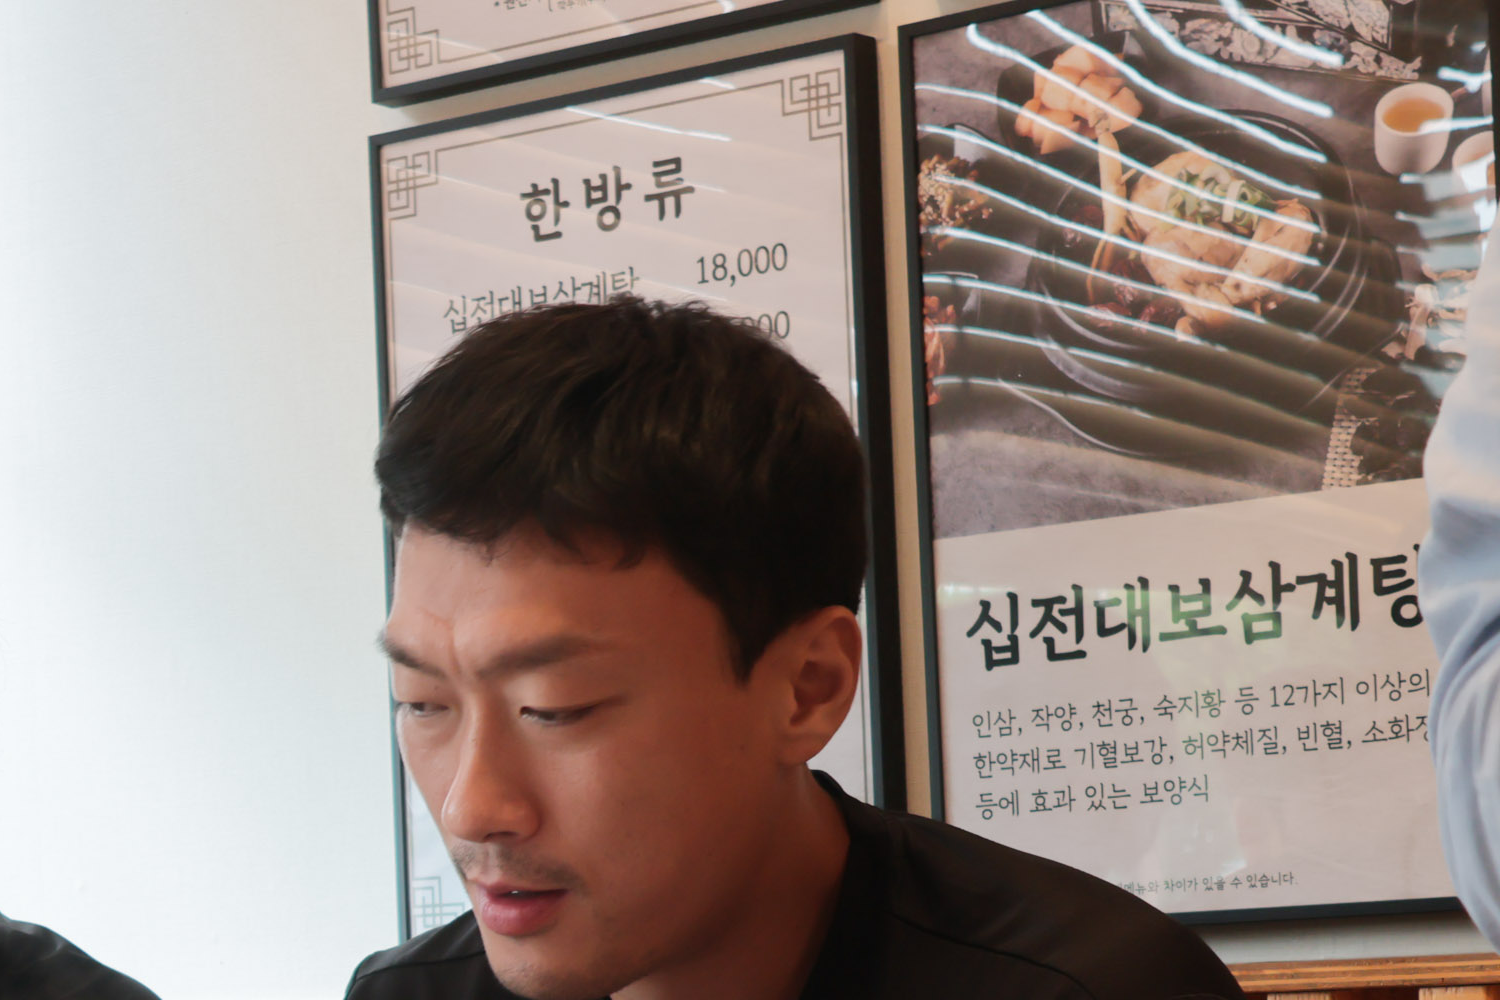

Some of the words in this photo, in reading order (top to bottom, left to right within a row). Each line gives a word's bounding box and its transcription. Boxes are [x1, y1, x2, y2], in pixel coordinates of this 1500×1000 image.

[520, 156, 696, 242] 한방류
[696, 242, 788, 286] 18,000
[972, 708, 1023, 738] 인삼,
[1031, 703, 1084, 733] 작양,
[1092, 698, 1146, 727] 천궁,
[1153, 689, 1226, 722] 숙지황
[1234, 686, 1260, 716] 등
[1269, 676, 1345, 708] 12가지
[1356, 668, 1430, 702] 이상의
[973, 747, 1067, 779] 한약재로
[1074, 736, 1174, 770] 기혈보강,
[1182, 726, 1287, 760] 허약체질,
[1297, 720, 1352, 752] 빈혈,
[975, 789, 1020, 820] 등에
[1029, 785, 1076, 813] 효과
[1085, 782, 1131, 812] 있는
[1140, 774, 1209, 806] 보양식
[1164, 877, 1198, 893] 차이가
[1202, 876, 1226, 891] 있을
[1230, 876, 1243, 889] 수
